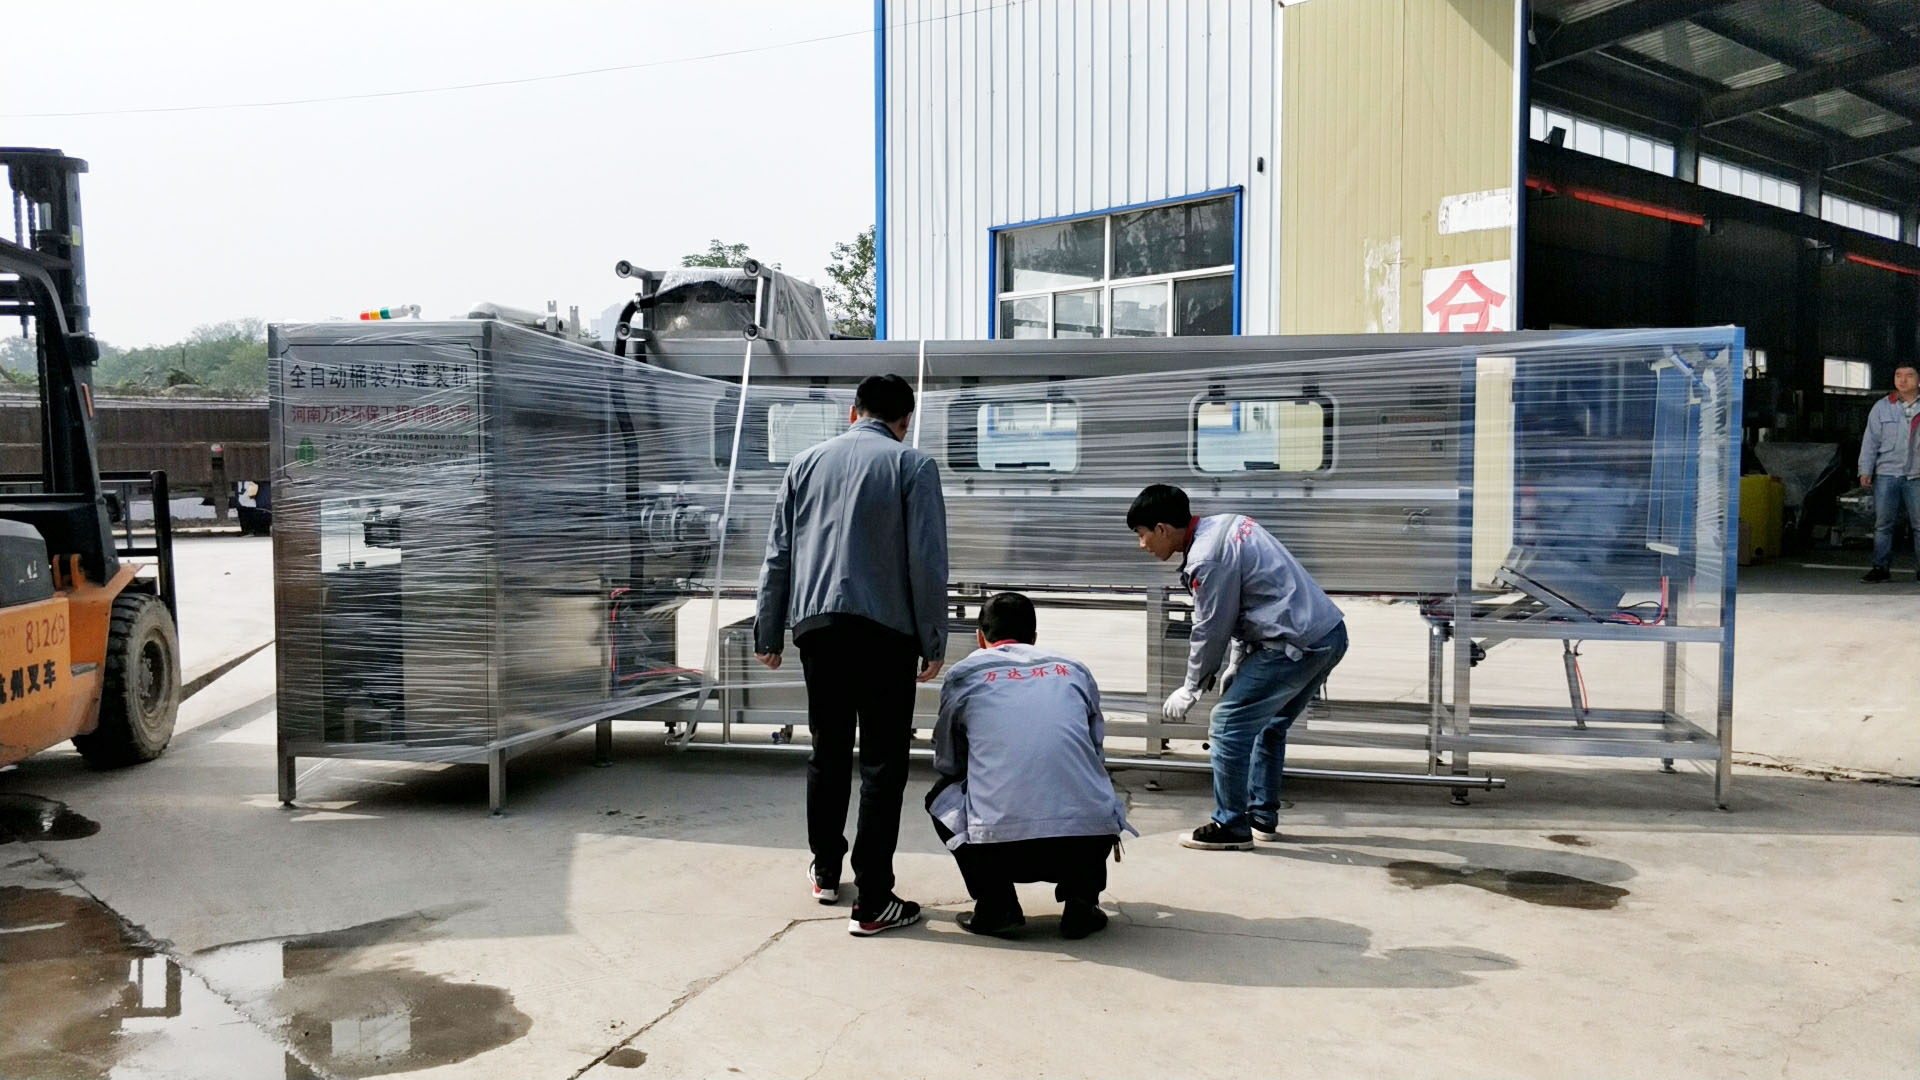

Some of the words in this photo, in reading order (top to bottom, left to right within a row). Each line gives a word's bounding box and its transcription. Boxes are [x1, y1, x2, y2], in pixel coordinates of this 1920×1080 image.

[290, 363, 471, 389] 全自动桶装水灌装机
[292, 404, 471, 425] 河南万达环保工程有限公司
[25, 613, 66, 654] 81269
[983, 663, 1071, 684] 万达环保
